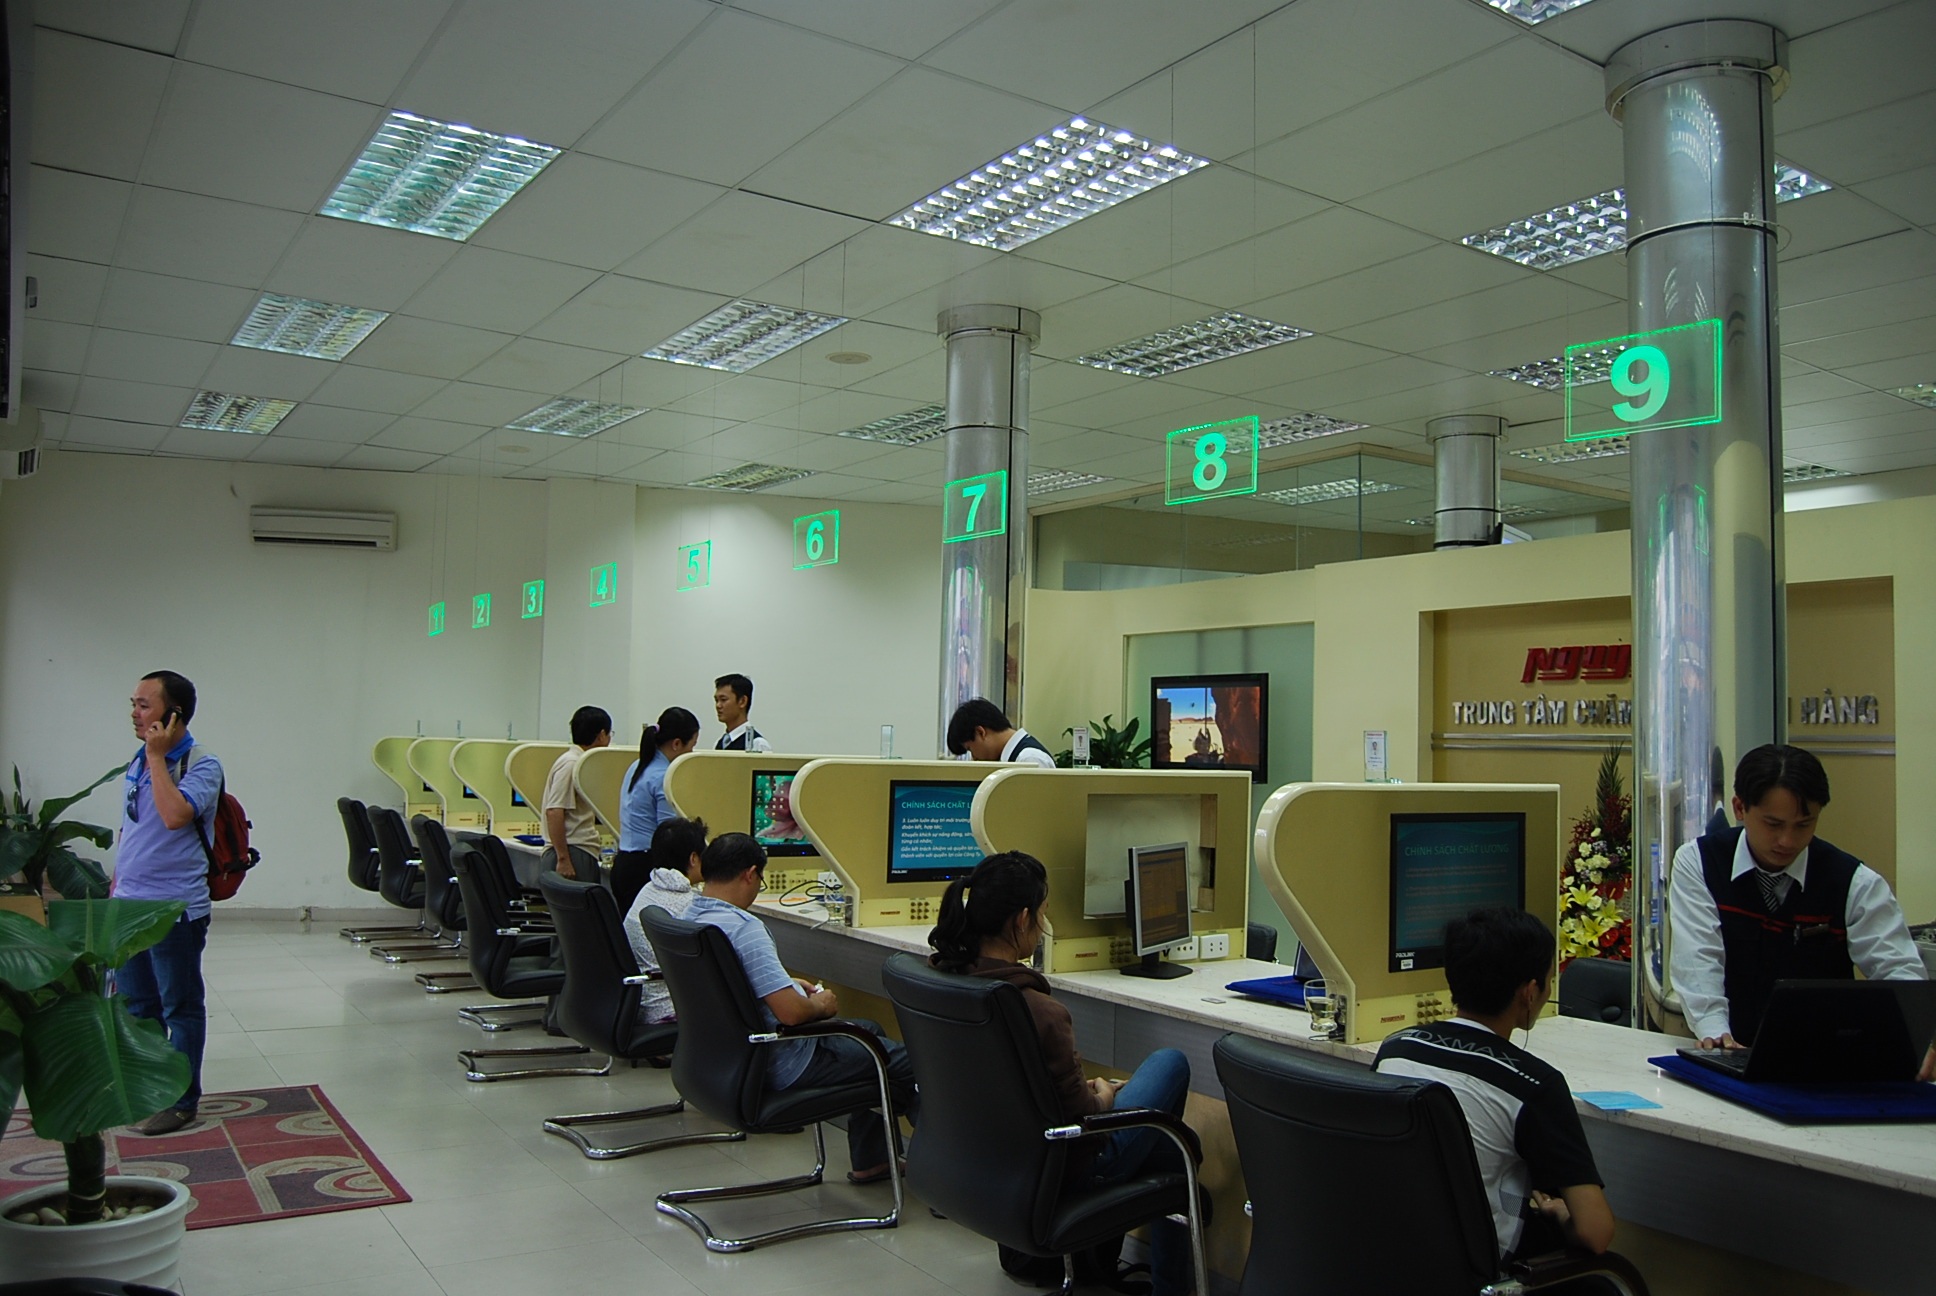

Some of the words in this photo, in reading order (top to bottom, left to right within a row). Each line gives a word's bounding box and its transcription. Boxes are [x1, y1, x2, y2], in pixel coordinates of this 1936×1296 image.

[1611, 345, 1669, 422] 9
[1193, 432, 1227, 491] 8
[963, 483, 987, 532] 7
[806, 520, 824, 560] 6
[688, 549, 700, 582] 5
[528, 586, 537, 613] 3
[597, 569, 608, 600] 4
[477, 599, 485, 623] 2
[1452, 700, 1515, 725] TRUNG
[1521, 693, 1567, 725] TÂM
[1801, 688, 1879, 724] HÀNG
[902, 801, 925, 809] CHÍNH
[927, 801, 946, 809] SÁCH
[1404, 844, 1432, 856] CHÍNH
[1434, 844, 1456, 855] SÁCH
